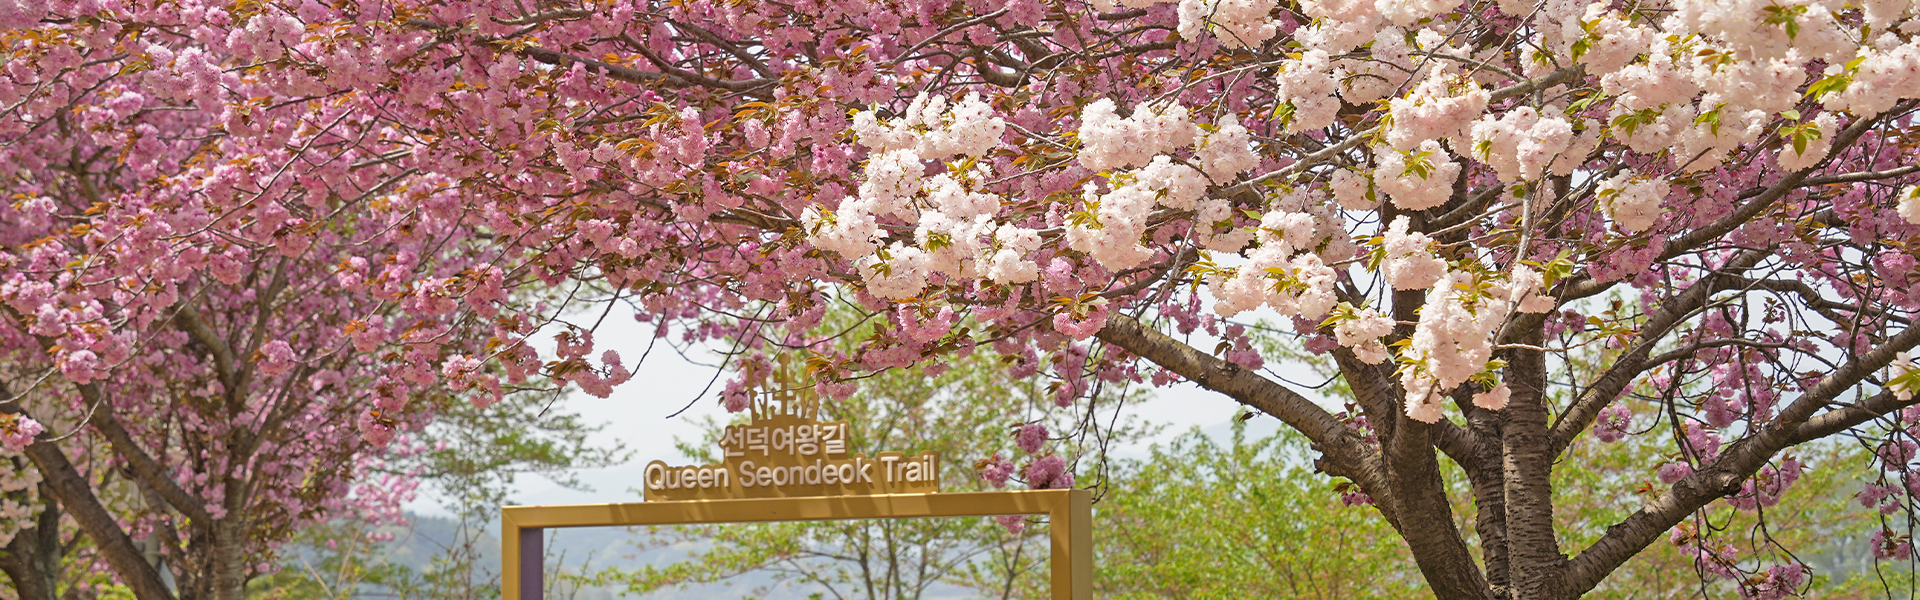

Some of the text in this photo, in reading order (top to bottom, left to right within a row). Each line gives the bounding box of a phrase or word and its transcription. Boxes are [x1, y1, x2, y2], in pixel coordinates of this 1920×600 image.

[720, 423, 847, 457] 선덕여왕길
[645, 454, 936, 490] Queen Seondeok Trail
